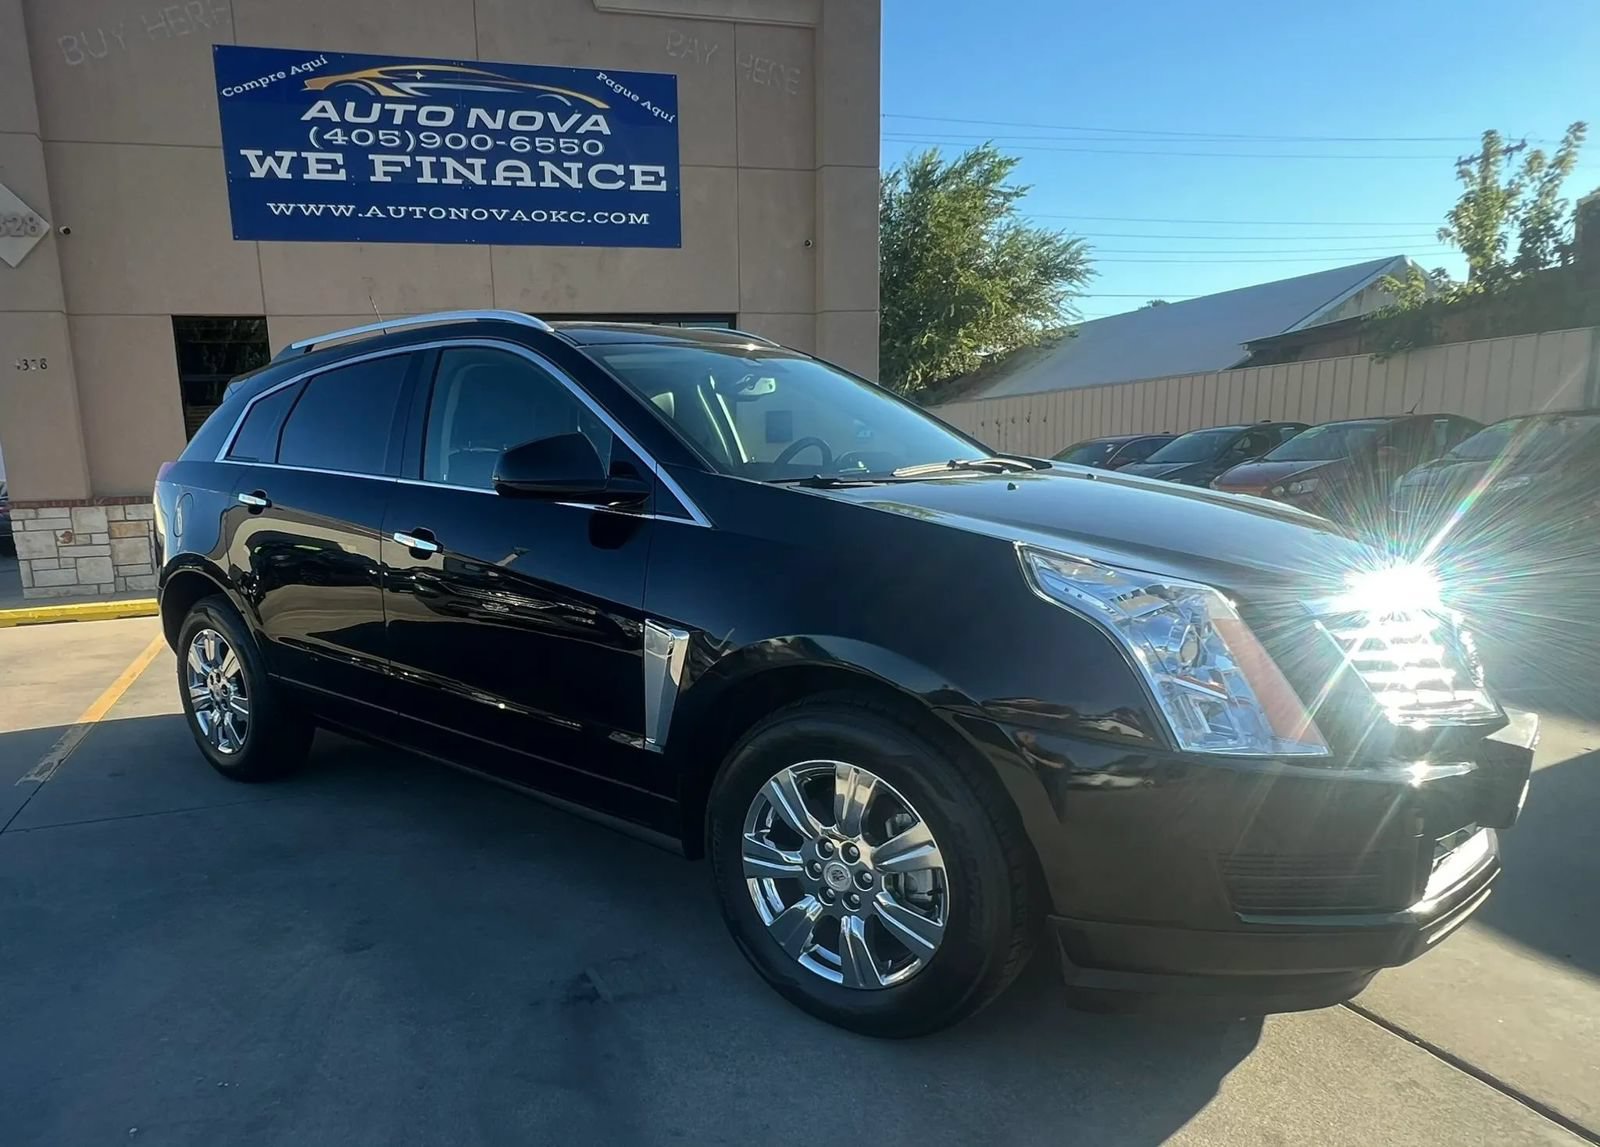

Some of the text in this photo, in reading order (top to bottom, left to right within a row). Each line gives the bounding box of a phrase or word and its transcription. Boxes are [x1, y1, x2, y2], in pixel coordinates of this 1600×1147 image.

[57, 23, 127, 66] BUY
[222, 53, 329, 97] Compre Aquí
[301, 100, 612, 135] AUTO NOVA
[595, 72, 676, 123] Pague Aquí
[308, 126, 605, 157] (405)900-6550
[240, 149, 668, 192] WE FINANCE
[266, 202, 651, 226] WWW.AUTONOVAOKC.COM
